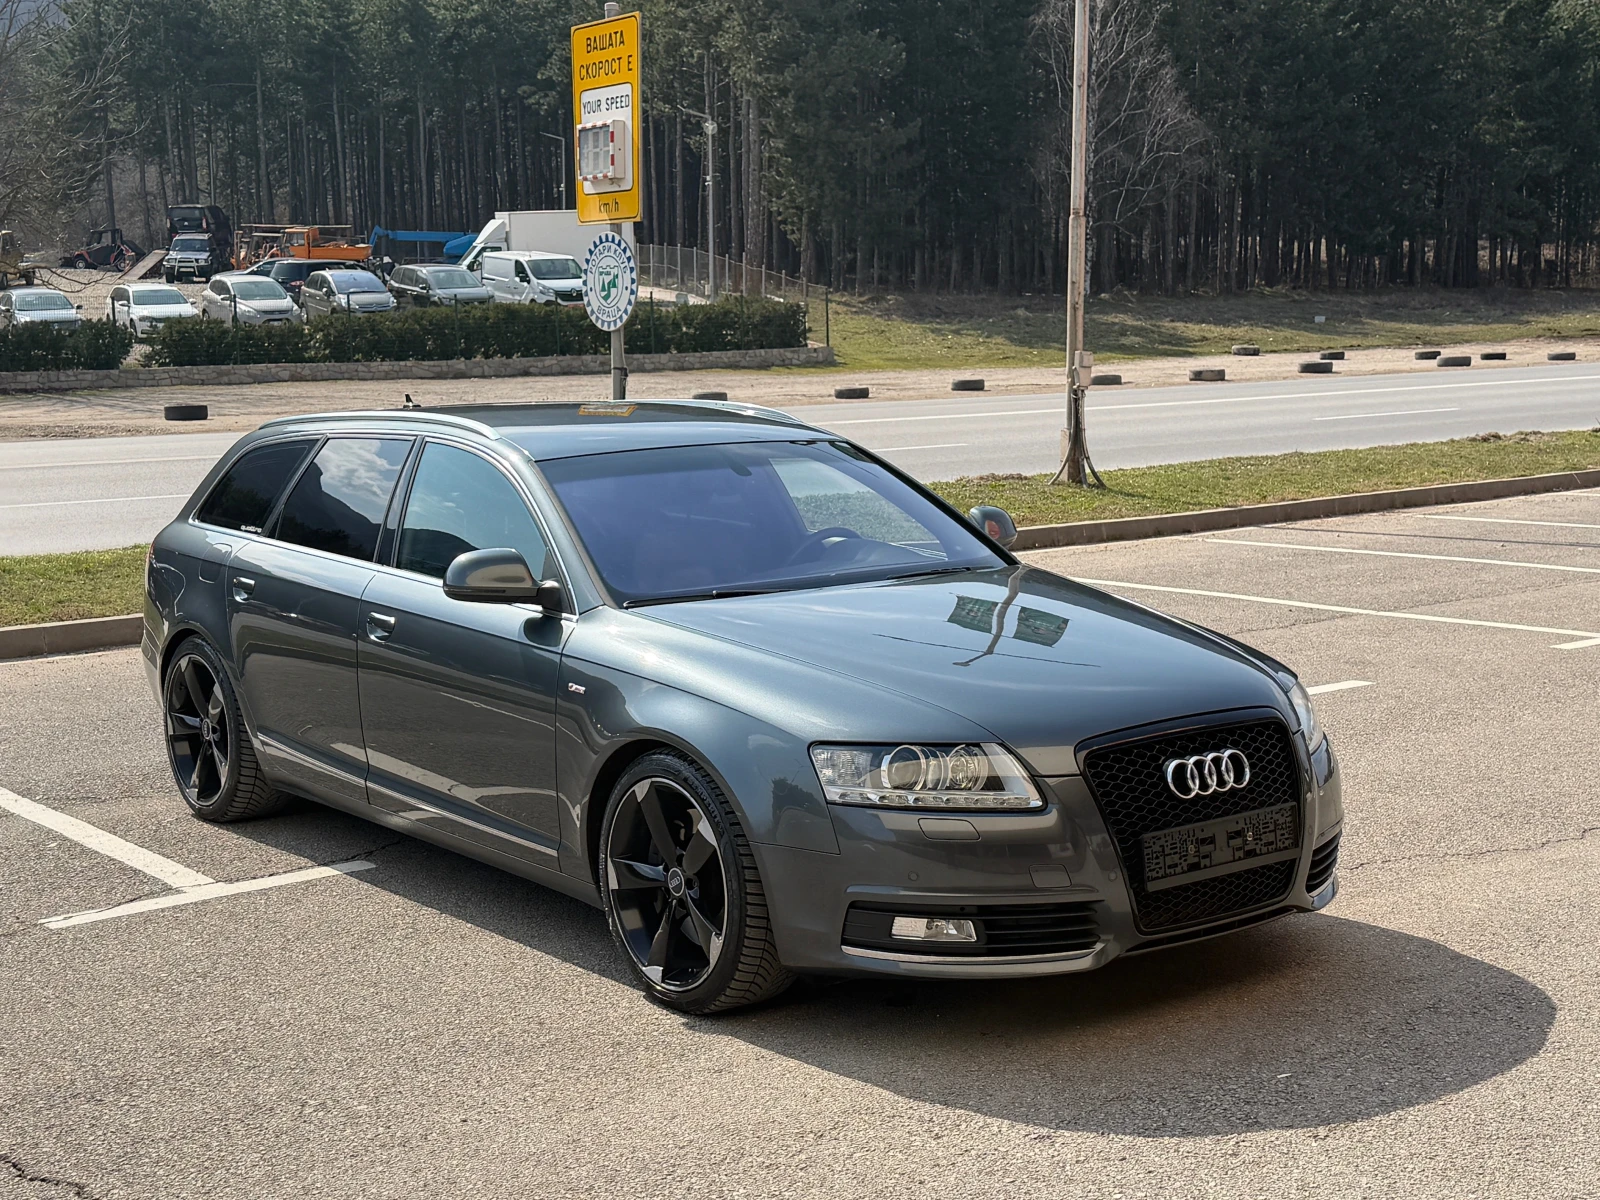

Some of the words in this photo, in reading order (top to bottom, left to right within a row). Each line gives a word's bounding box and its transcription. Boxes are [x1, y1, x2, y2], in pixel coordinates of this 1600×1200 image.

[586, 30, 625, 54] ВАШАТА
[579, 56, 622, 81] СКОРОСТ
[627, 54, 633, 71] Е
[582, 99, 602, 115] YOUR
[605, 94, 630, 111] SPEED
[598, 198, 619, 214] km/h
[588, 244, 612, 275] РОТАРИ
[596, 304, 622, 319] ВРАЦА
